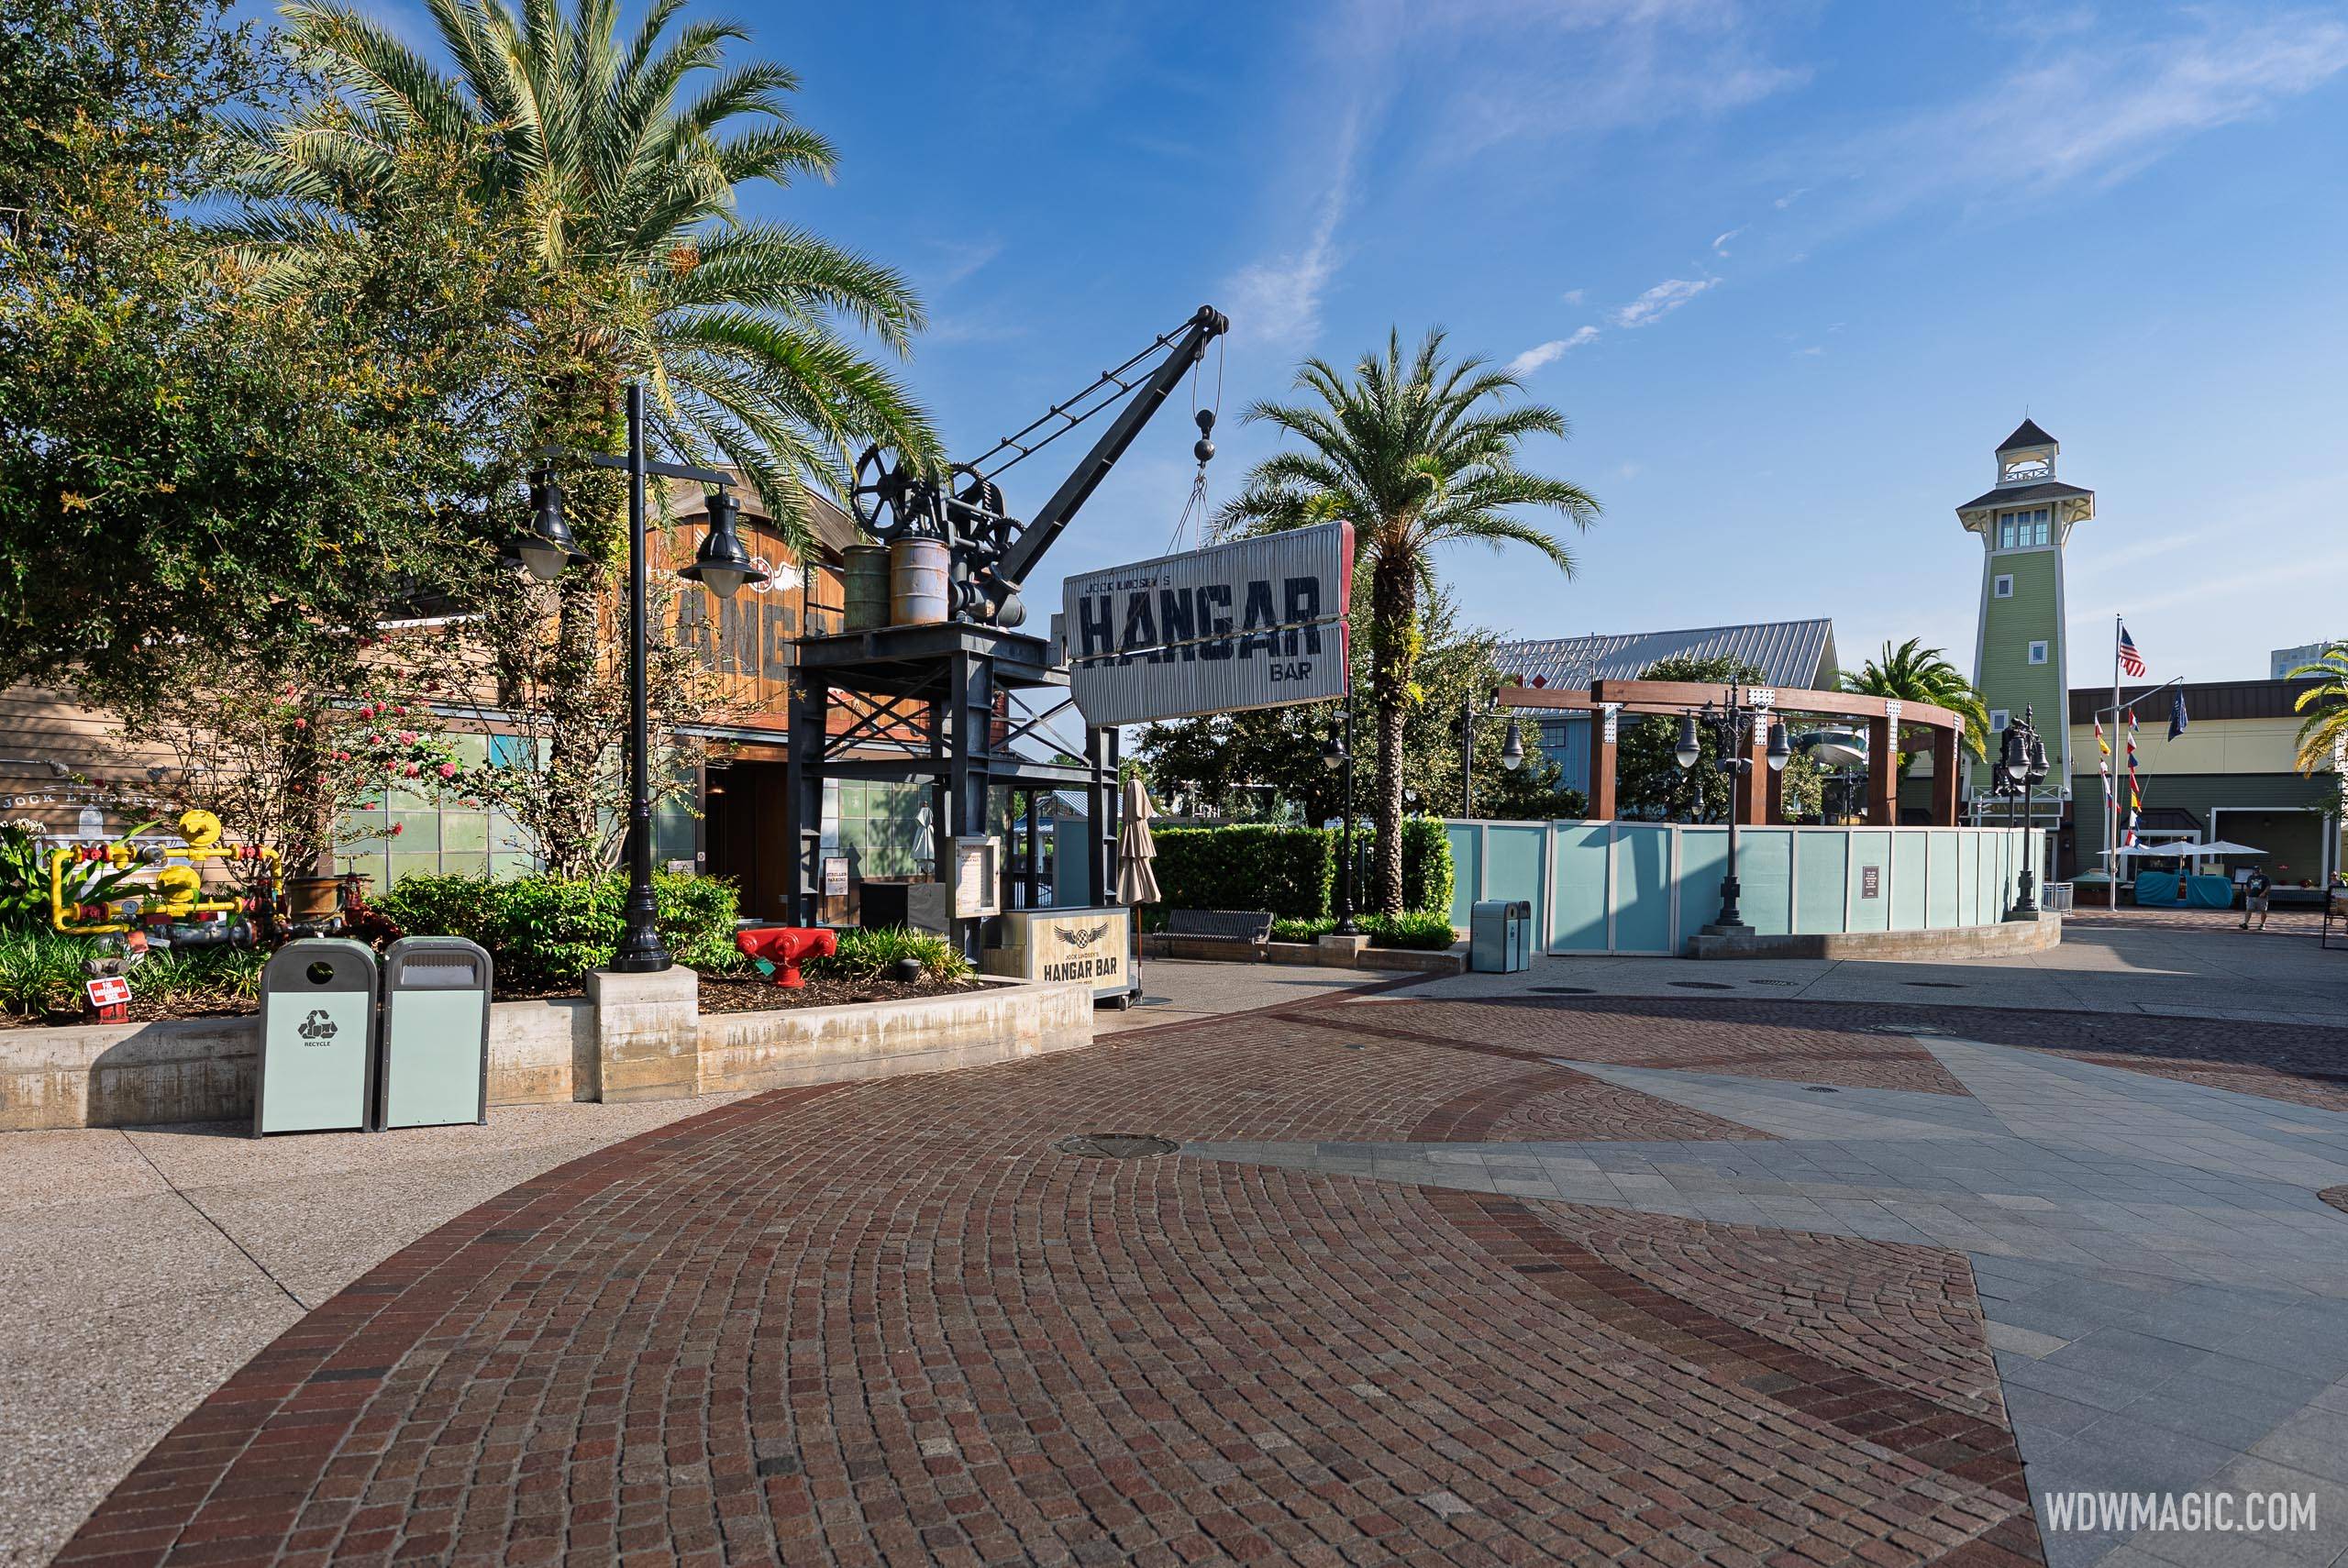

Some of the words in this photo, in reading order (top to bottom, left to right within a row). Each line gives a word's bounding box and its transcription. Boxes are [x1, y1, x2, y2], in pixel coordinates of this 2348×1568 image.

[1086, 581, 1113, 594] JOCK
[1117, 575, 1170, 591] LINDSEYS
[1079, 576, 1322, 669] HANGAR
[1270, 661, 1312, 682] BAR
[3, 794, 56, 810] JOCK
[1044, 960, 1092, 981] HANGAR
[1095, 956, 1117, 977] BAR
